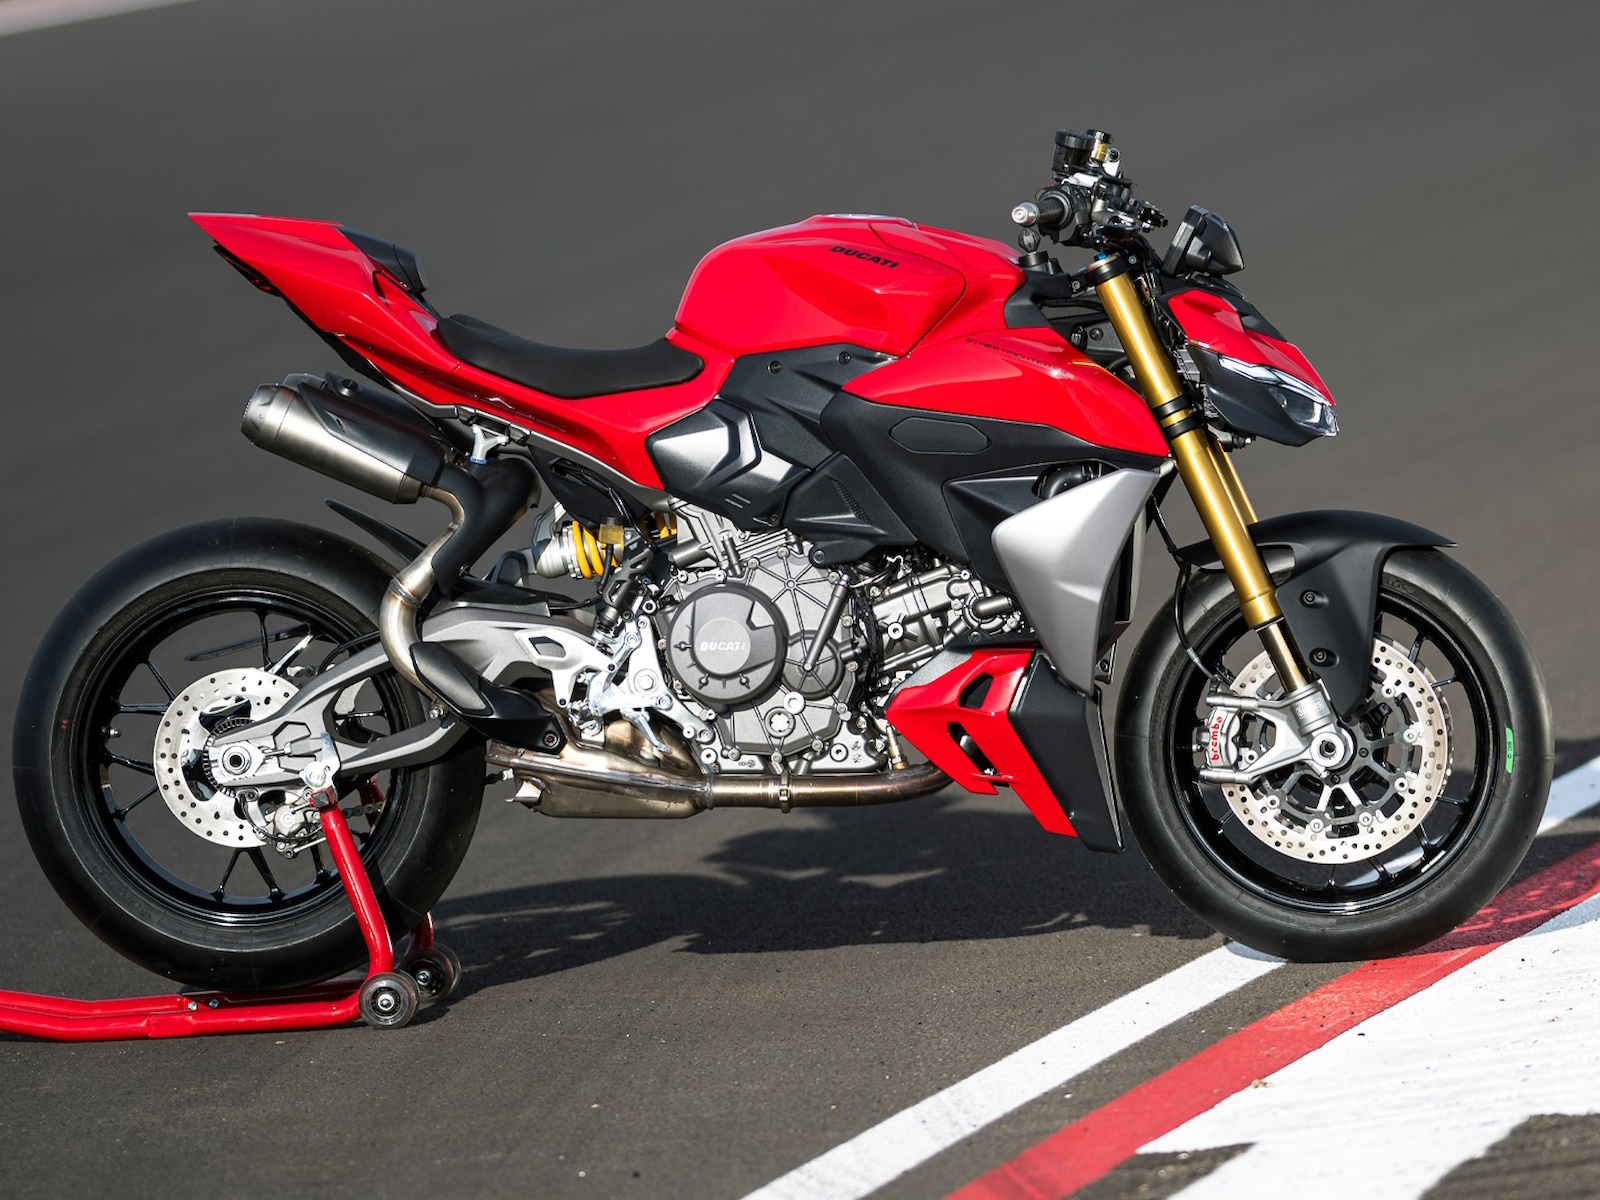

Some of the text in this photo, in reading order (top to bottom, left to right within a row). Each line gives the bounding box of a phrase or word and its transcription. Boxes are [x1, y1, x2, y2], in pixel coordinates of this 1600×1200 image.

[830, 246, 899, 269] DUCATI
[700, 641, 746, 652] DUCATI
[1211, 716, 1223, 762] brembo
